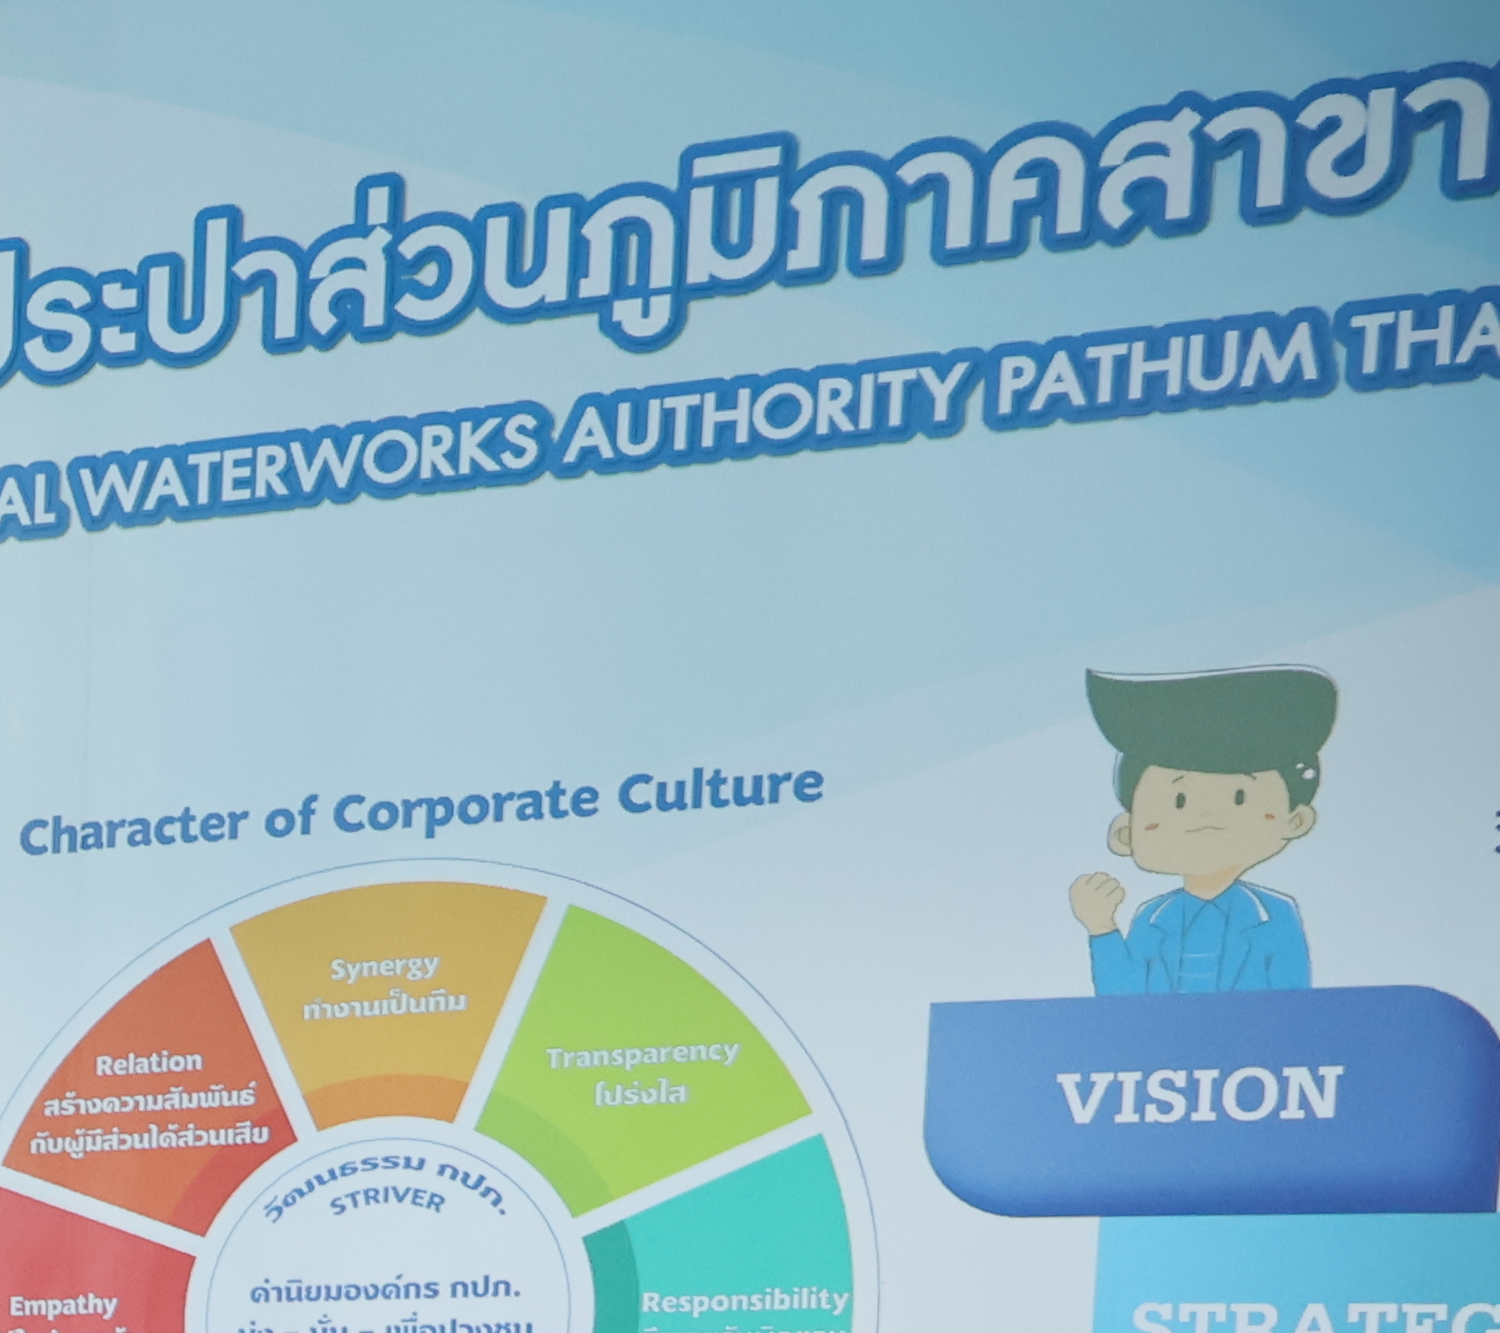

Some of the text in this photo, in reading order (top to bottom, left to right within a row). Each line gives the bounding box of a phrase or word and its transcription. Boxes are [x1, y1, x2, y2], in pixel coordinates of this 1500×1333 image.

[70, 402, 552, 532] WATERWORKS
[556, 348, 982, 479] AUTHORITY
[986, 305, 1336, 436] PATHUM
[19, 768, 826, 857] Character of Corporate Culture
[330, 956, 441, 985] Synergy
[303, 988, 468, 1020] ทำงานเป็นทีม
[95, 1050, 203, 1076] Relation
[546, 1043, 740, 1071] Transparency
[43, 1081, 257, 1117] สร้างความสัมพันธ์
[594, 1077, 689, 1106] โปร่งใส
[1056, 1065, 1344, 1124] VISION
[30, 1121, 270, 1159] กับผู้มีส่วนได้ส่วนเสีย
[263, 1155, 507, 1224] วัฒนธรรม กปภ.
[329, 1186, 446, 1216] STRIVER
[250, 1273, 521, 1303] ค่านิยมองค์กร กปภ.
[641, 1286, 850, 1318] Responsibility
[9, 1292, 118, 1321] Empathy
